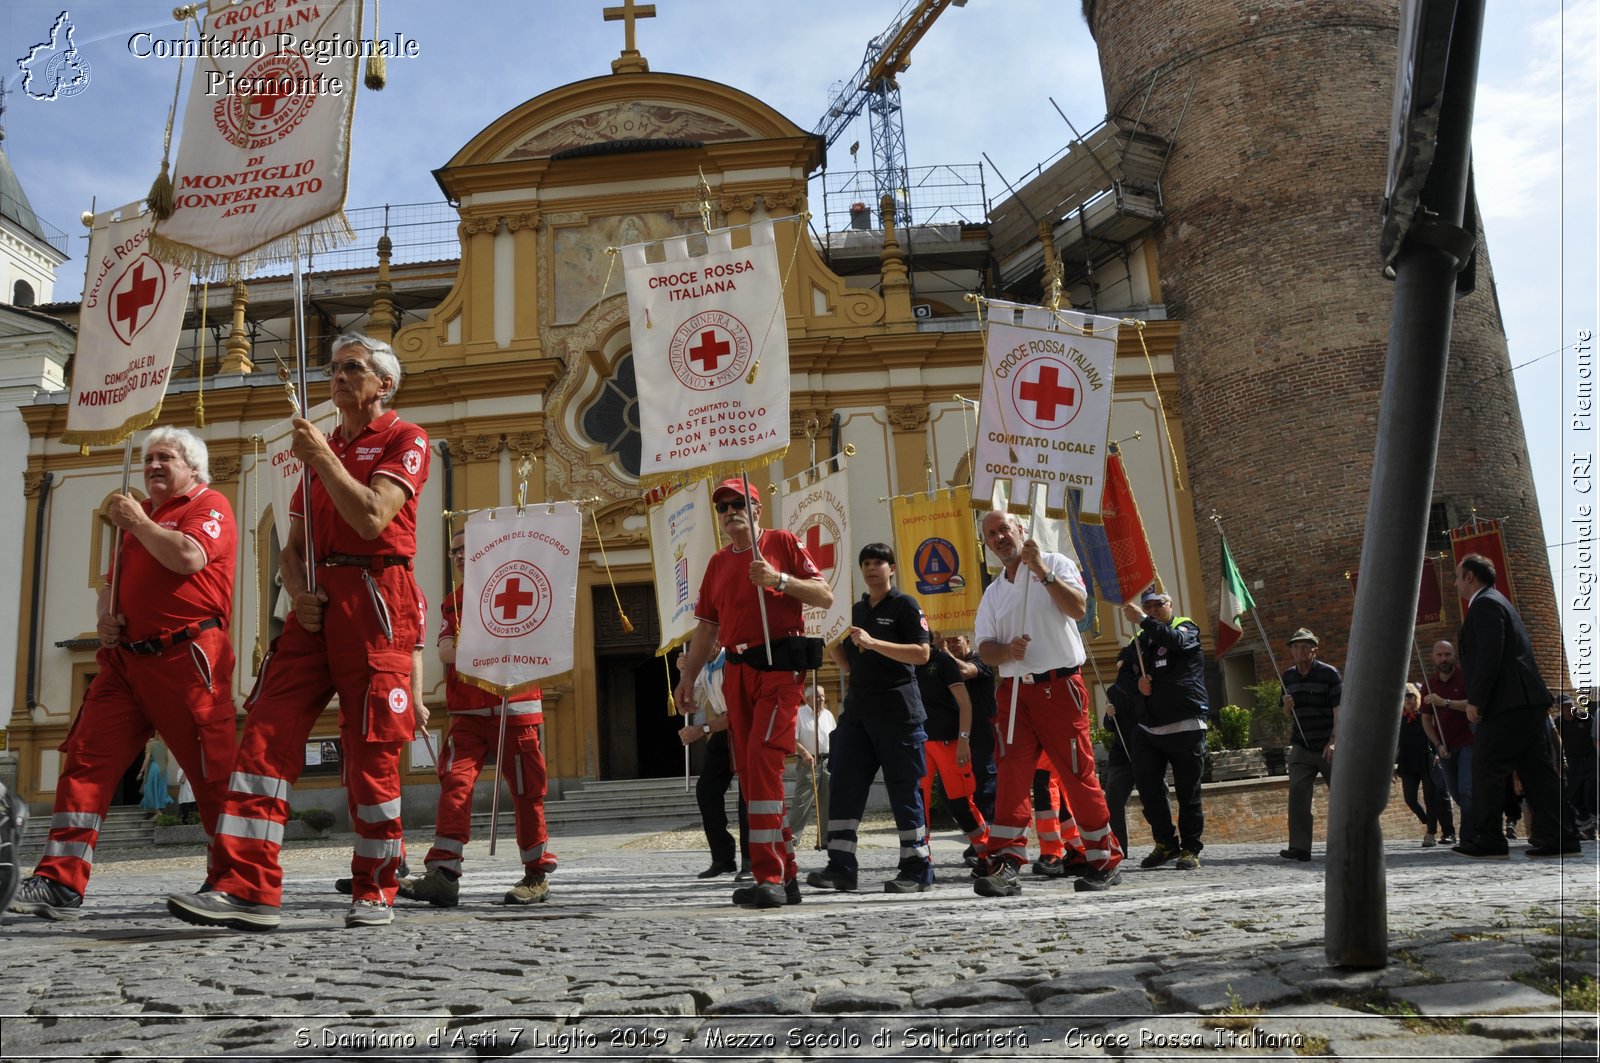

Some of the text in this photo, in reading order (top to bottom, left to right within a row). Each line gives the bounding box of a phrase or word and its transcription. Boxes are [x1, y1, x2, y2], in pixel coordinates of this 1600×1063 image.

[214, 0, 276, 30] CROCE
[232, 5, 321, 45] ITALIANA
[257, 57, 291, 72] GINEVRA
[273, 107, 293, 126] 1864
[249, 135, 277, 150] DEL
[246, 155, 265, 168] DI
[179, 159, 315, 191] MONTIGLIO
[173, 177, 323, 211] MONFERRATO
[220, 203, 258, 219] ASTI
[87, 256, 116, 308] CROCE
[648, 259, 755, 289] CROCE ROSSA
[669, 279, 737, 302] ITALIANA
[146, 354, 156, 367] DI
[672, 313, 749, 388] CONVENZIONE DI GINEVRA 22 AGOSTO 1864
[995, 339, 1104, 392] CROCE ROSSA ITALIANA
[688, 400, 741, 417] COMITATO DI
[667, 407, 767, 435] CASTELNUOVO
[655, 429, 777, 462] E PIOVA' MASSAIA
[676, 422, 757, 446] DON BOSCO
[988, 431, 1096, 455] COMITATO LOCALE
[271, 448, 297, 467] CROC
[1037, 453, 1048, 465] DI
[985, 463, 1056, 481] COCCONATO
[1059, 471, 1093, 486] D'ASTI
[798, 490, 822, 513] ROSSA
[823, 490, 848, 533] ITALIANA
[470, 530, 570, 563] VOLONTARI DEL SOCCORSO
[483, 563, 549, 604] CONVENZIONE DI GINEVRA
[487, 617, 538, 635] 22 AGOSTO 1864
[472, 653, 552, 668] Gruppo di MONTA'
